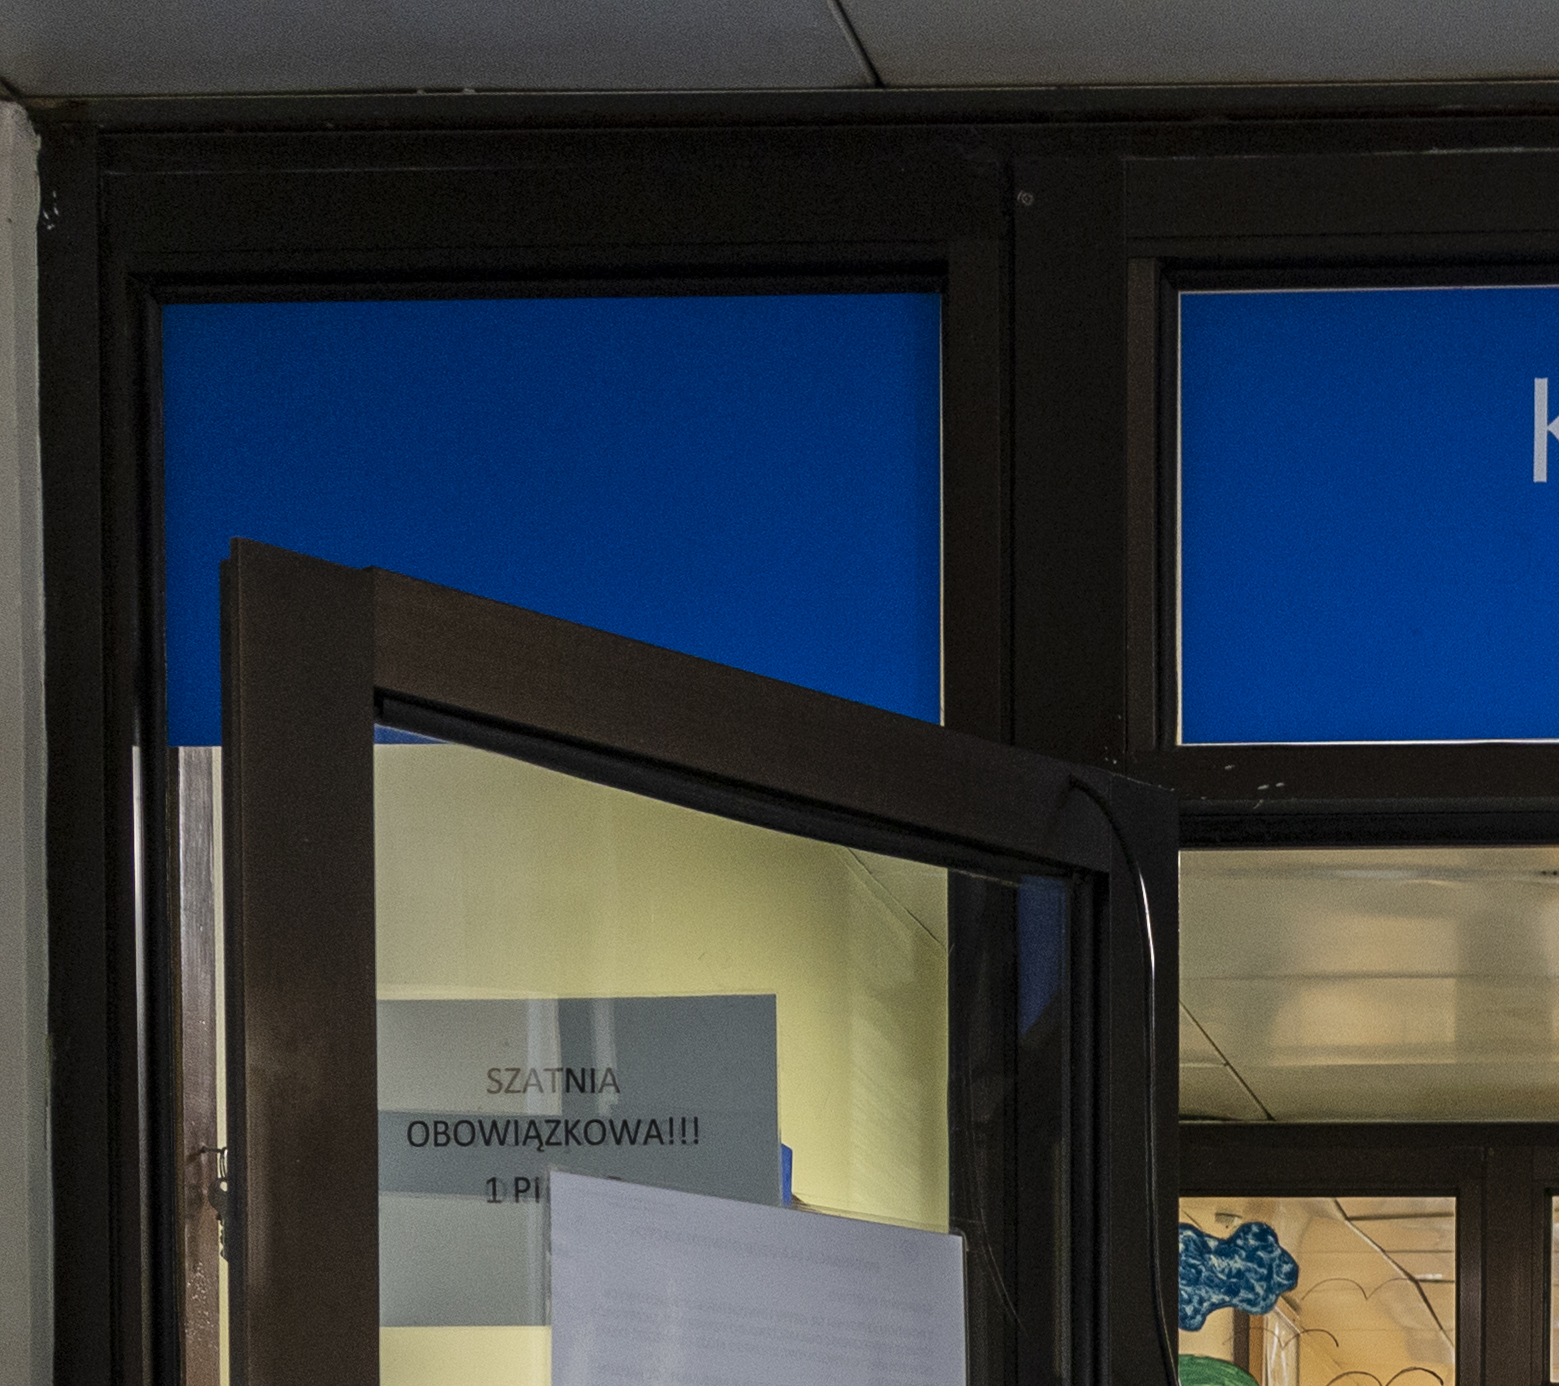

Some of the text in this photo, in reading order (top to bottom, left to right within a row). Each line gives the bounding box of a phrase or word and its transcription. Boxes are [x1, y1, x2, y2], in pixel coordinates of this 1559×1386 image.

[485, 1066, 621, 1095] SZATNIA
[406, 1116, 699, 1152] OBOWIĄZKOWA!!!
[485, 1176, 502, 1204] 1
